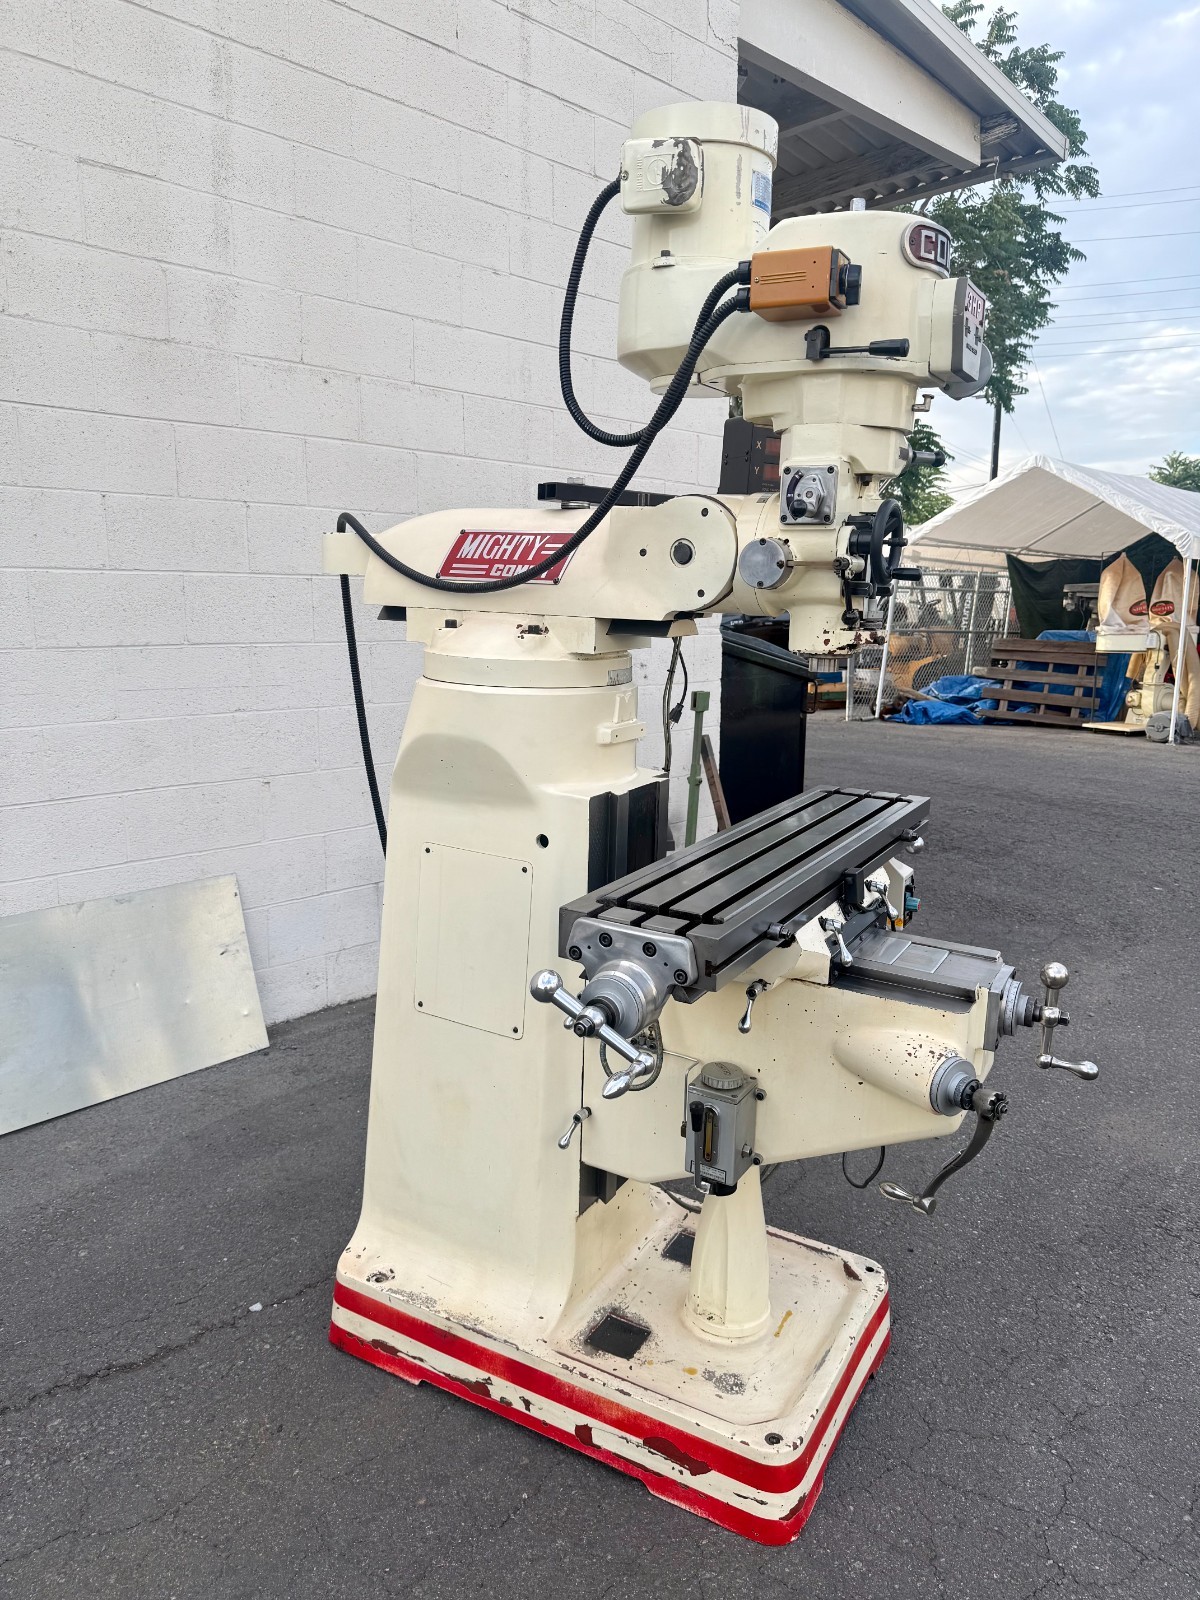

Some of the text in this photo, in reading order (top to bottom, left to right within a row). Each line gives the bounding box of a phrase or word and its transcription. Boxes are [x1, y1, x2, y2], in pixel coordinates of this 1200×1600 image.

[920, 229, 950, 269] CO
[756, 440, 762, 450] X
[754, 466, 760, 475] Y
[456, 533, 549, 561] MIGHTY
[489, 563, 554, 579] COM
[960, 592, 972, 632] HYUNDA
